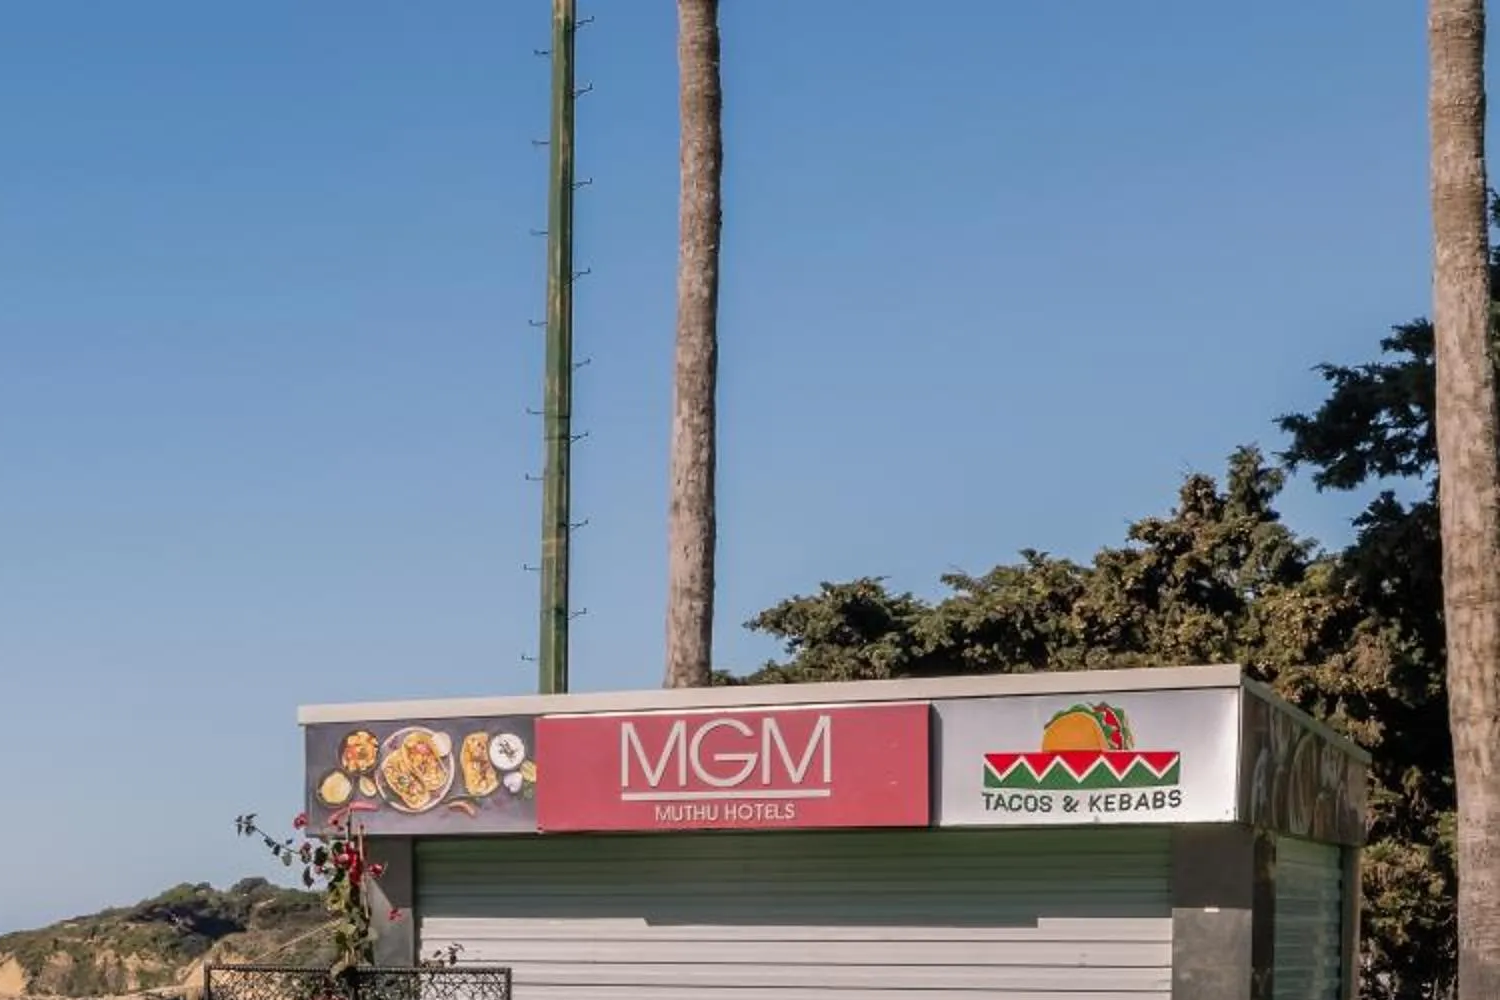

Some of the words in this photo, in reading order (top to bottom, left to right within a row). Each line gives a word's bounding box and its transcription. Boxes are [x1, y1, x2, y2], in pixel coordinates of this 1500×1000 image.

[621, 715, 831, 787] MGM
[655, 804, 719, 821] MUTHU
[724, 803, 795, 821] HOTELS
[982, 793, 1053, 813] TACOS
[1063, 795, 1079, 813] &
[1089, 790, 1182, 812] KEBABS
